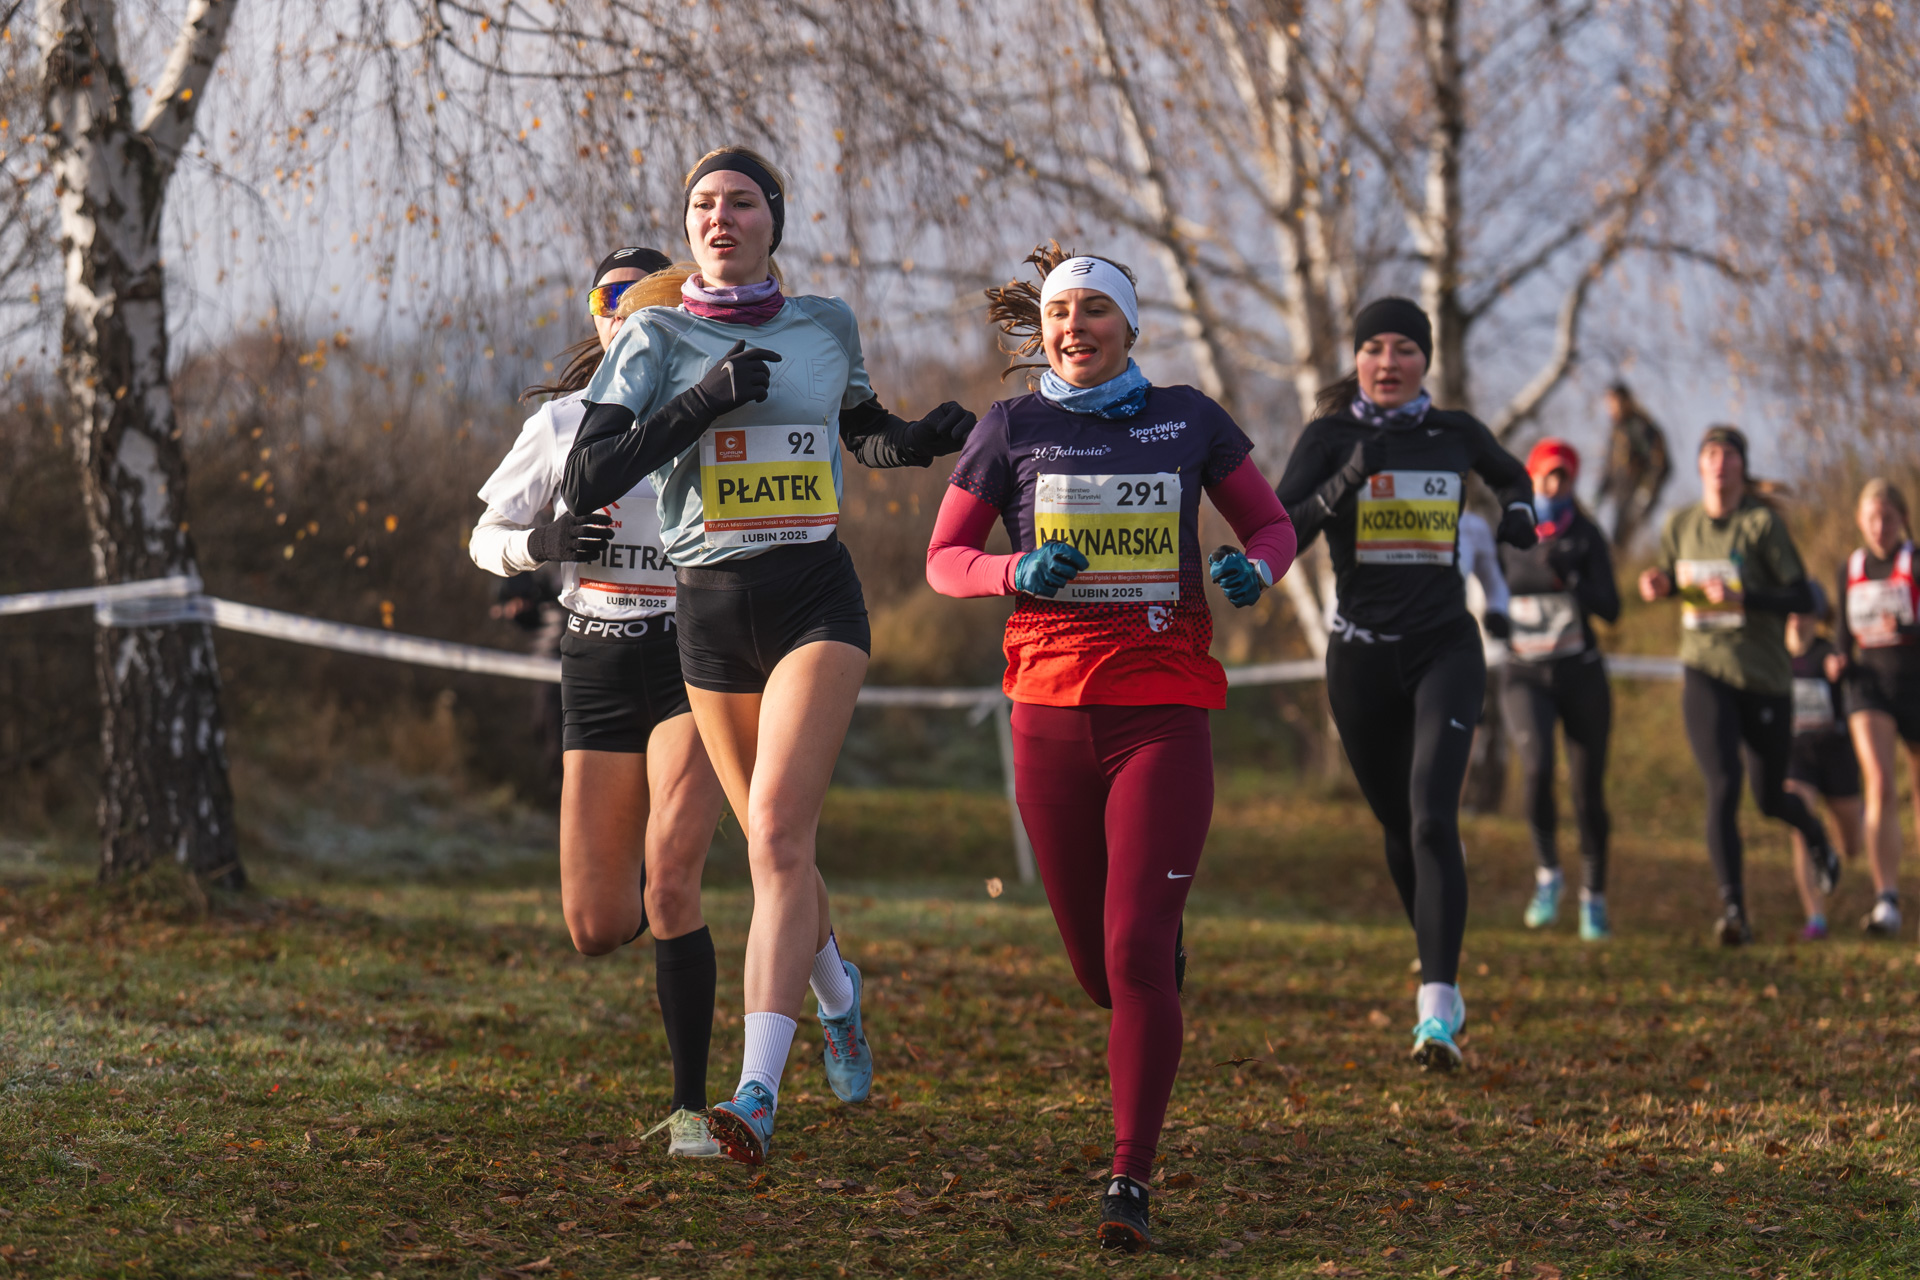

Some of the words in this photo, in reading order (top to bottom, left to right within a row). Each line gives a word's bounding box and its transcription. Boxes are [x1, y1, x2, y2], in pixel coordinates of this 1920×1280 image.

[1129, 421, 1187, 439] SportWise
[787, 432, 815, 454] 92
[718, 475, 822, 505] PŁATEK
[1116, 481, 1168, 506] 291
[1424, 476, 1448, 496] 62
[742, 532, 777, 543] LUBIN
[780, 531, 808, 541] 2025
[1072, 588, 1109, 598] LUBIN
[1111, 587, 1143, 597] 2025
[606, 596, 637, 607] LUBIN
[639, 598, 667, 608] 2025
[584, 620, 648, 638] PRO
